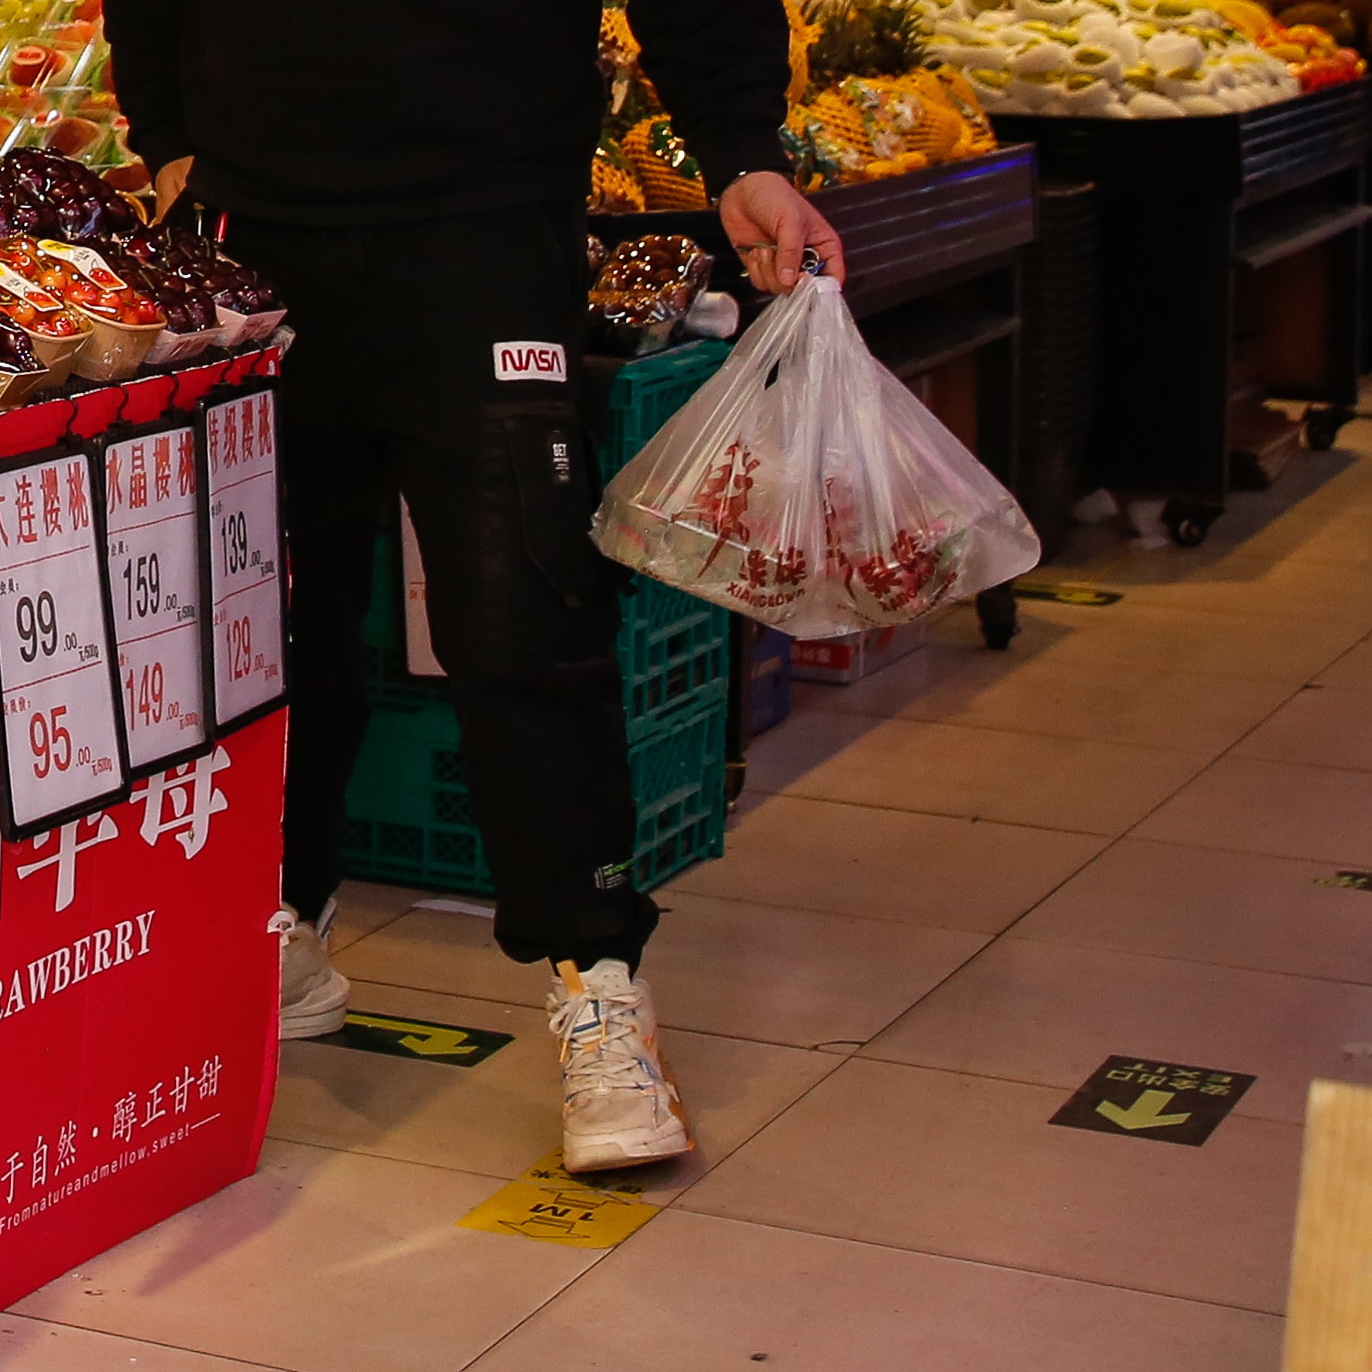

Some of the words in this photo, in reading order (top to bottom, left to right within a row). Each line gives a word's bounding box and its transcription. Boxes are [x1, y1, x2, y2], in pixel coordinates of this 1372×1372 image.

[501, 349, 562, 373] NASA
[107, 430, 196, 516] 水晶樱桃
[1105, 1069, 1231, 1096] 安全出口
